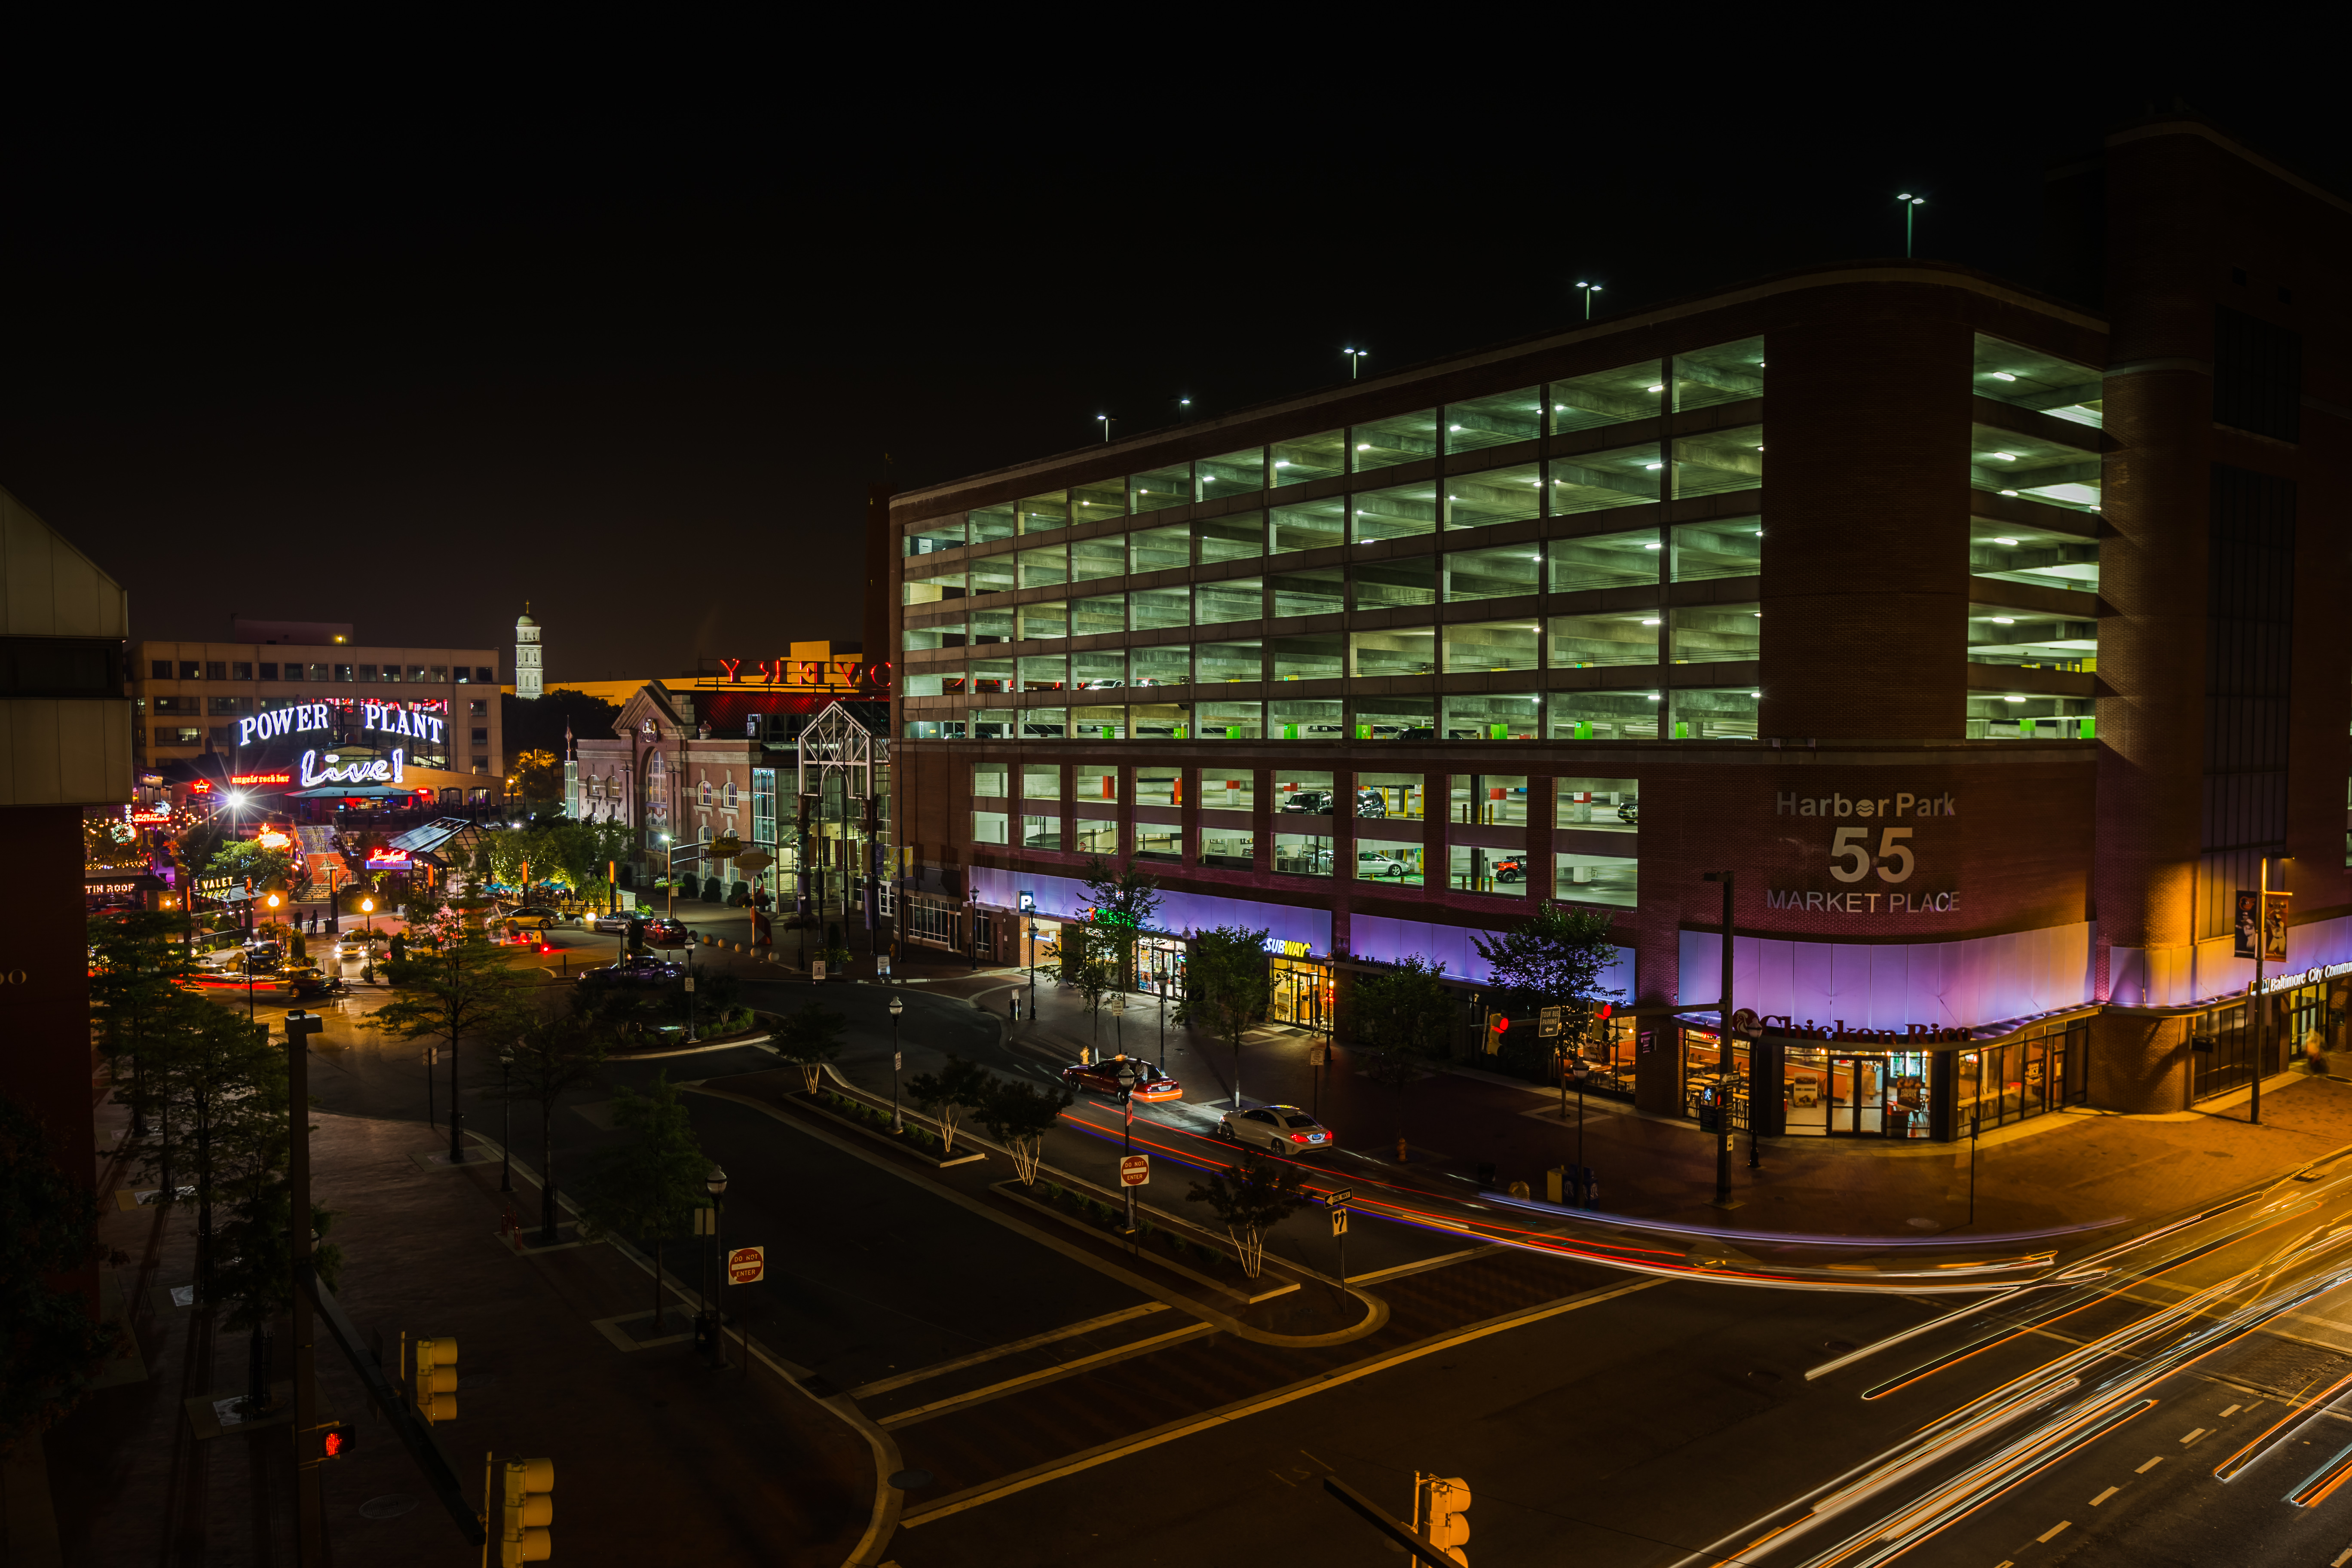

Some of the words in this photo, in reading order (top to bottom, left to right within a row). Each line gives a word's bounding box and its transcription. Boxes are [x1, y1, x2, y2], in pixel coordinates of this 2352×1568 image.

[239, 704, 328, 746] POWER
[364, 704, 443, 744] PLANT
[232, 775, 258, 784] angels
[258, 775, 276, 783] rock
[276, 774, 289, 782] bar
[301, 748, 403, 787] Live!
[1777, 792, 1890, 817] Harbor
[1896, 792, 1956, 817] Park
[1829, 827, 1914, 883] 55
[85, 884, 104, 894] TIN
[107, 883, 135, 893] ROOF
[202, 876, 233, 890] VALET
[1020, 895, 1032, 910] P
[1767, 889, 1881, 913] MARKET
[1889, 892, 1960, 913] PLACE
[1264, 938, 1312, 957] SUBWAY
[2270, 974, 2306, 992] Baltimore
[2308, 967, 2323, 983] City
[1761, 1015, 1896, 1045] Chicken
[1905, 1023, 1972, 1044] Rico
